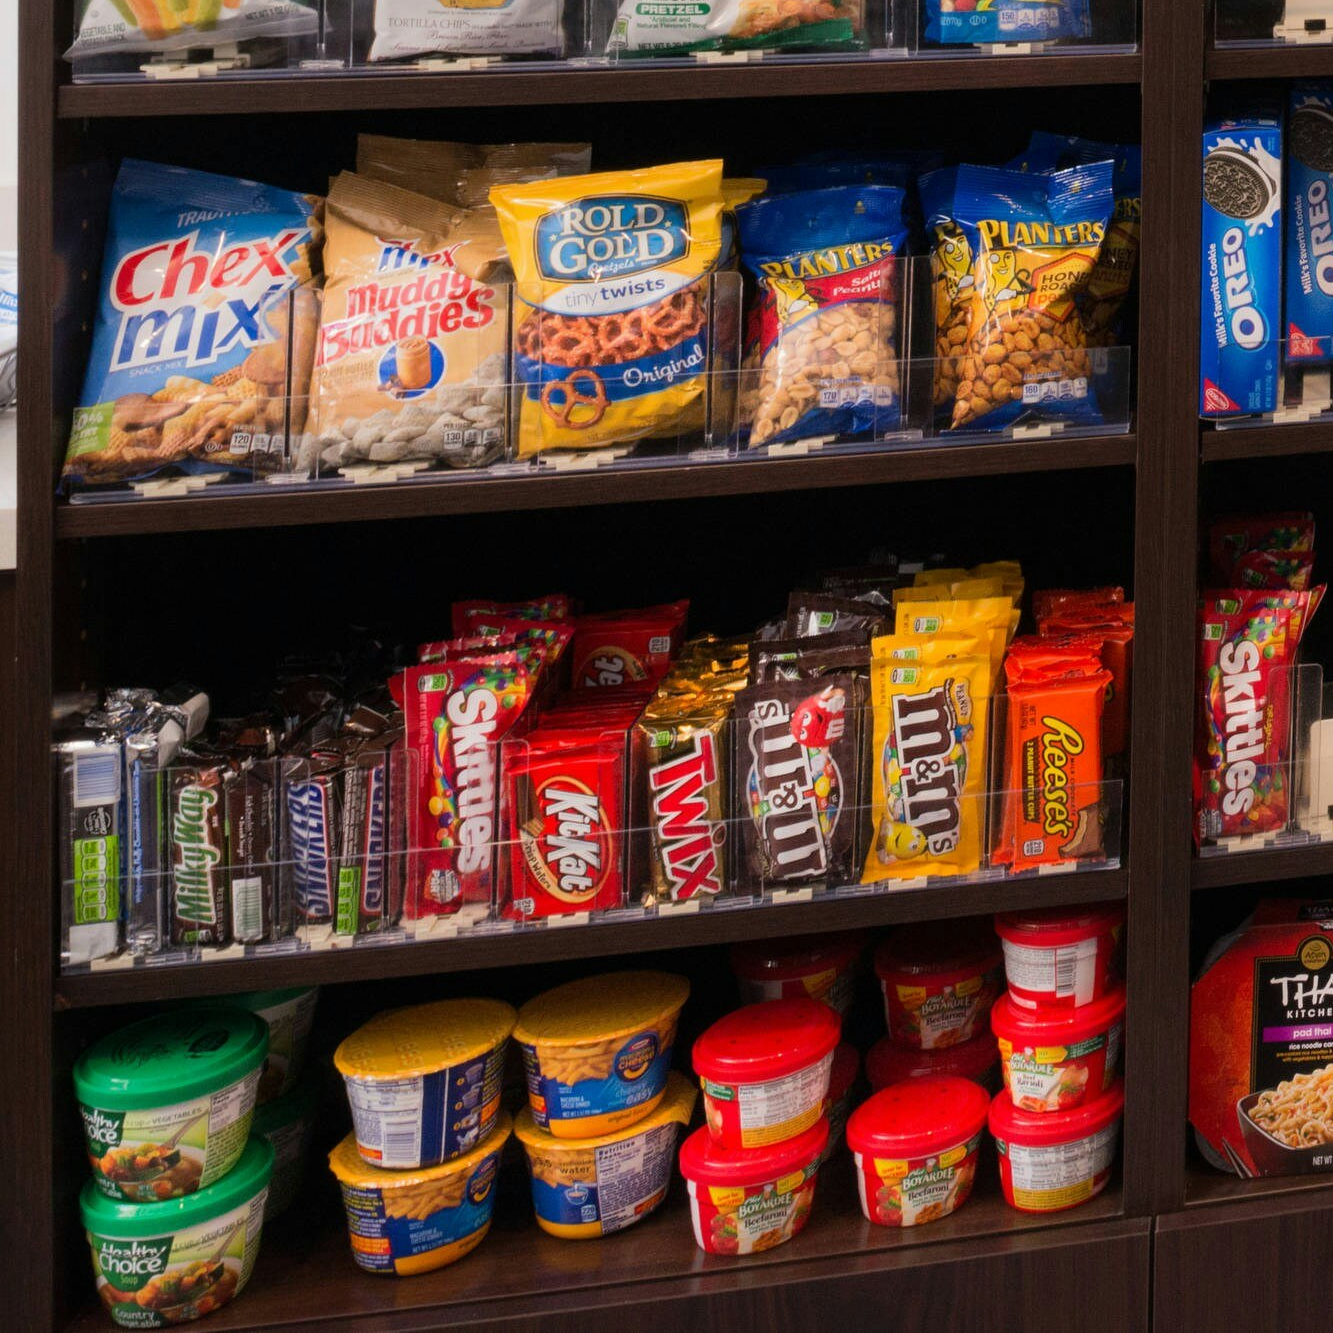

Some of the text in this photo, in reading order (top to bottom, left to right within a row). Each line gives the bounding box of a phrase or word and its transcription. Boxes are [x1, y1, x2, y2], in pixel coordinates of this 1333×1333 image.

[640, 4, 704, 15] PRETZEL
[559, 203, 666, 237] ROLD
[978, 219, 1105, 248] PLANTERS
[550, 227, 675, 275] GOLD
[761, 241, 894, 280] PLANTERS
[114, 232, 302, 308] Chex
[565, 276, 667, 310] tiny twists
[1207, 243, 1229, 349] Milk's Favorite Cookie
[1222, 226, 1267, 351] OREO
[318, 292, 495, 364] Buddies
[622, 344, 705, 388] Original
[954, 682, 968, 718] PEANUT
[1219, 640, 1263, 817] Skittles
[447, 689, 500, 874] Skittles
[1025, 750, 1035, 800] PEANUT BUTTER
[1042, 716, 1084, 838] Reese's
[651, 730, 720, 901] TWIX
[921, 996, 971, 1015] BOYARDEE
[1293, 1025, 1333, 1040] pad thai
[1300, 1040, 1323, 1049] noodle
[1313, 1155, 1323, 1166] NET
[902, 1166, 955, 1191] BOYARDEE
[907, 1185, 950, 1201] Beefaroni
[738, 1192, 792, 1218] BOYARDEE
[744, 1208, 788, 1228] Beefaroni
[99, 1253, 163, 1274] Choice
[101, 1241, 167, 1258] Healthy
